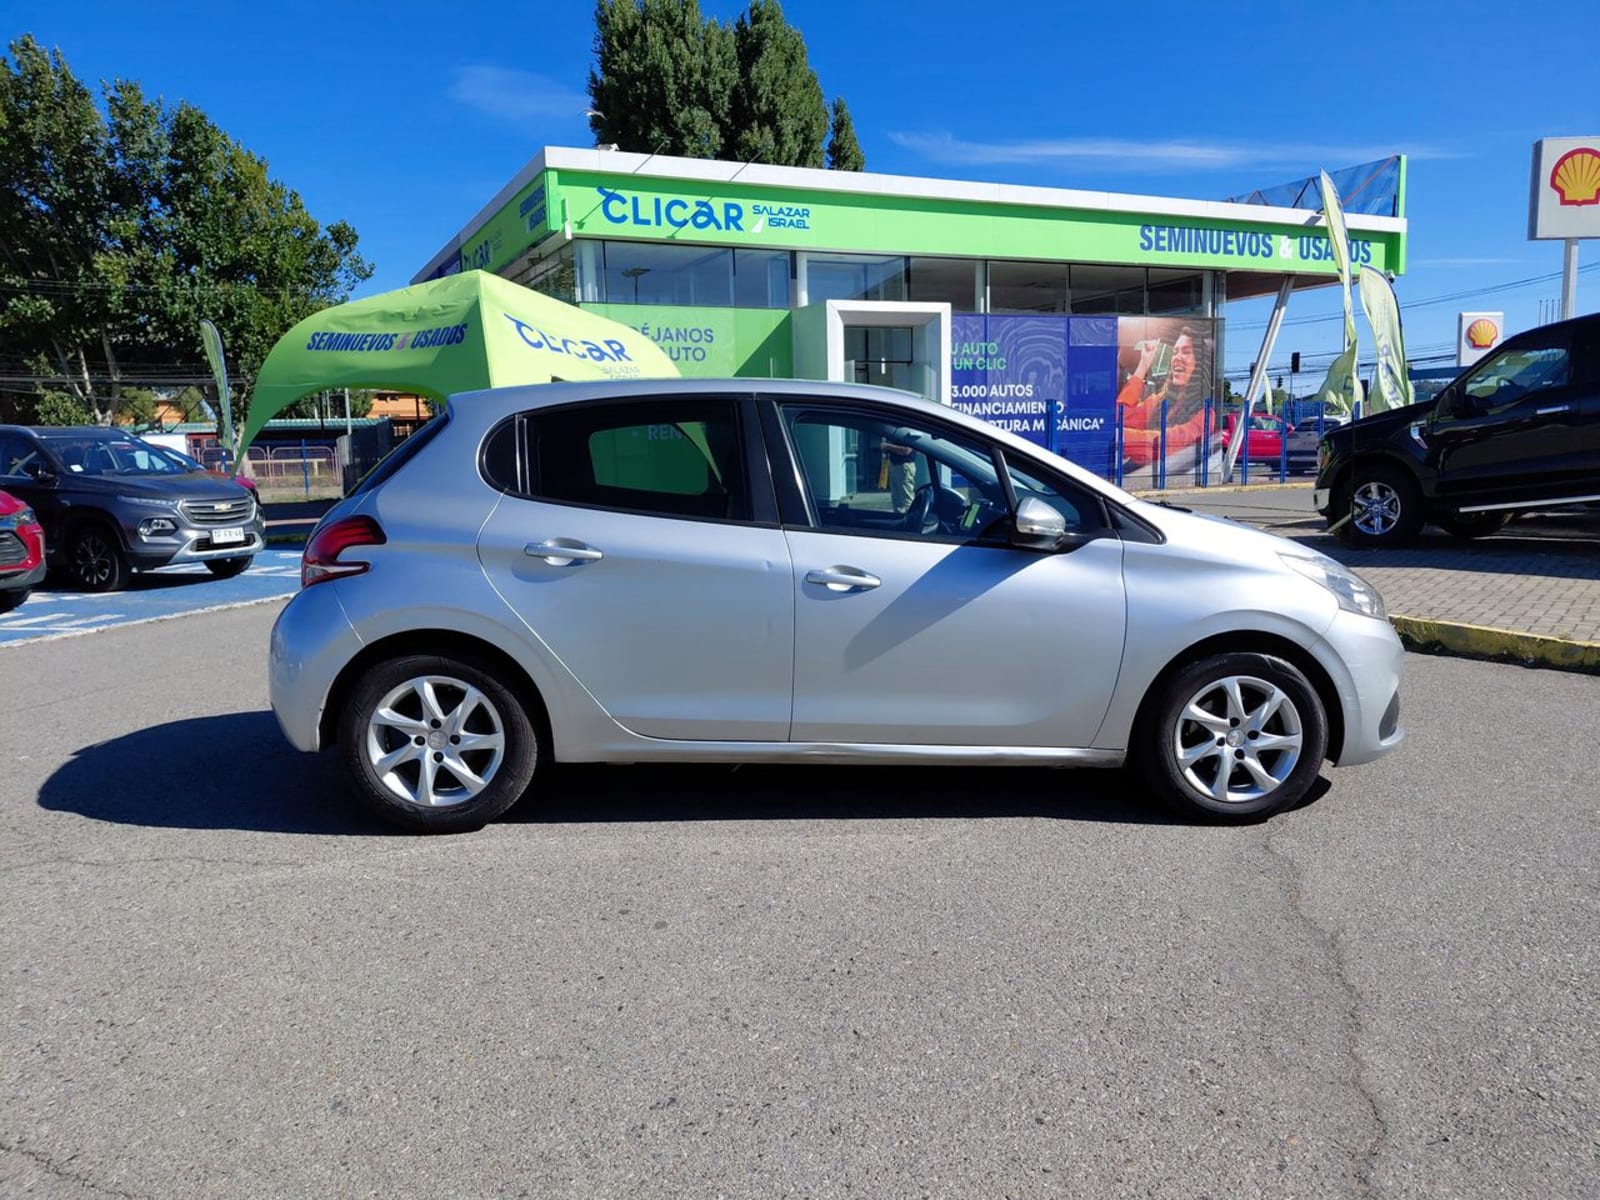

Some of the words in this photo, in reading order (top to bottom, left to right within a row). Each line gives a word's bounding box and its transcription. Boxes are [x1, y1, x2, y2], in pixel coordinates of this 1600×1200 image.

[752, 204, 810, 217] SALAZAR
[768, 217, 810, 229] ISRAEL
[1139, 224, 1273, 258] SEMINUEVOS
[1279, 236, 1293, 260] &
[1299, 236, 1372, 263] USAOS
[306, 331, 398, 351] SEMINUEVOS
[411, 323, 468, 349] USADOS
[631, 322, 714, 344] ÉJANOS
[660, 345, 706, 362] UTO
[961, 342, 998, 355] AUTO
[954, 358, 972, 371] UN
[976, 358, 1007, 371] CLIC
[951, 385, 987, 398] 3.000
[989, 384, 1034, 397] AUTOS
[951, 402, 1065, 416] FINANCIAMIENO
